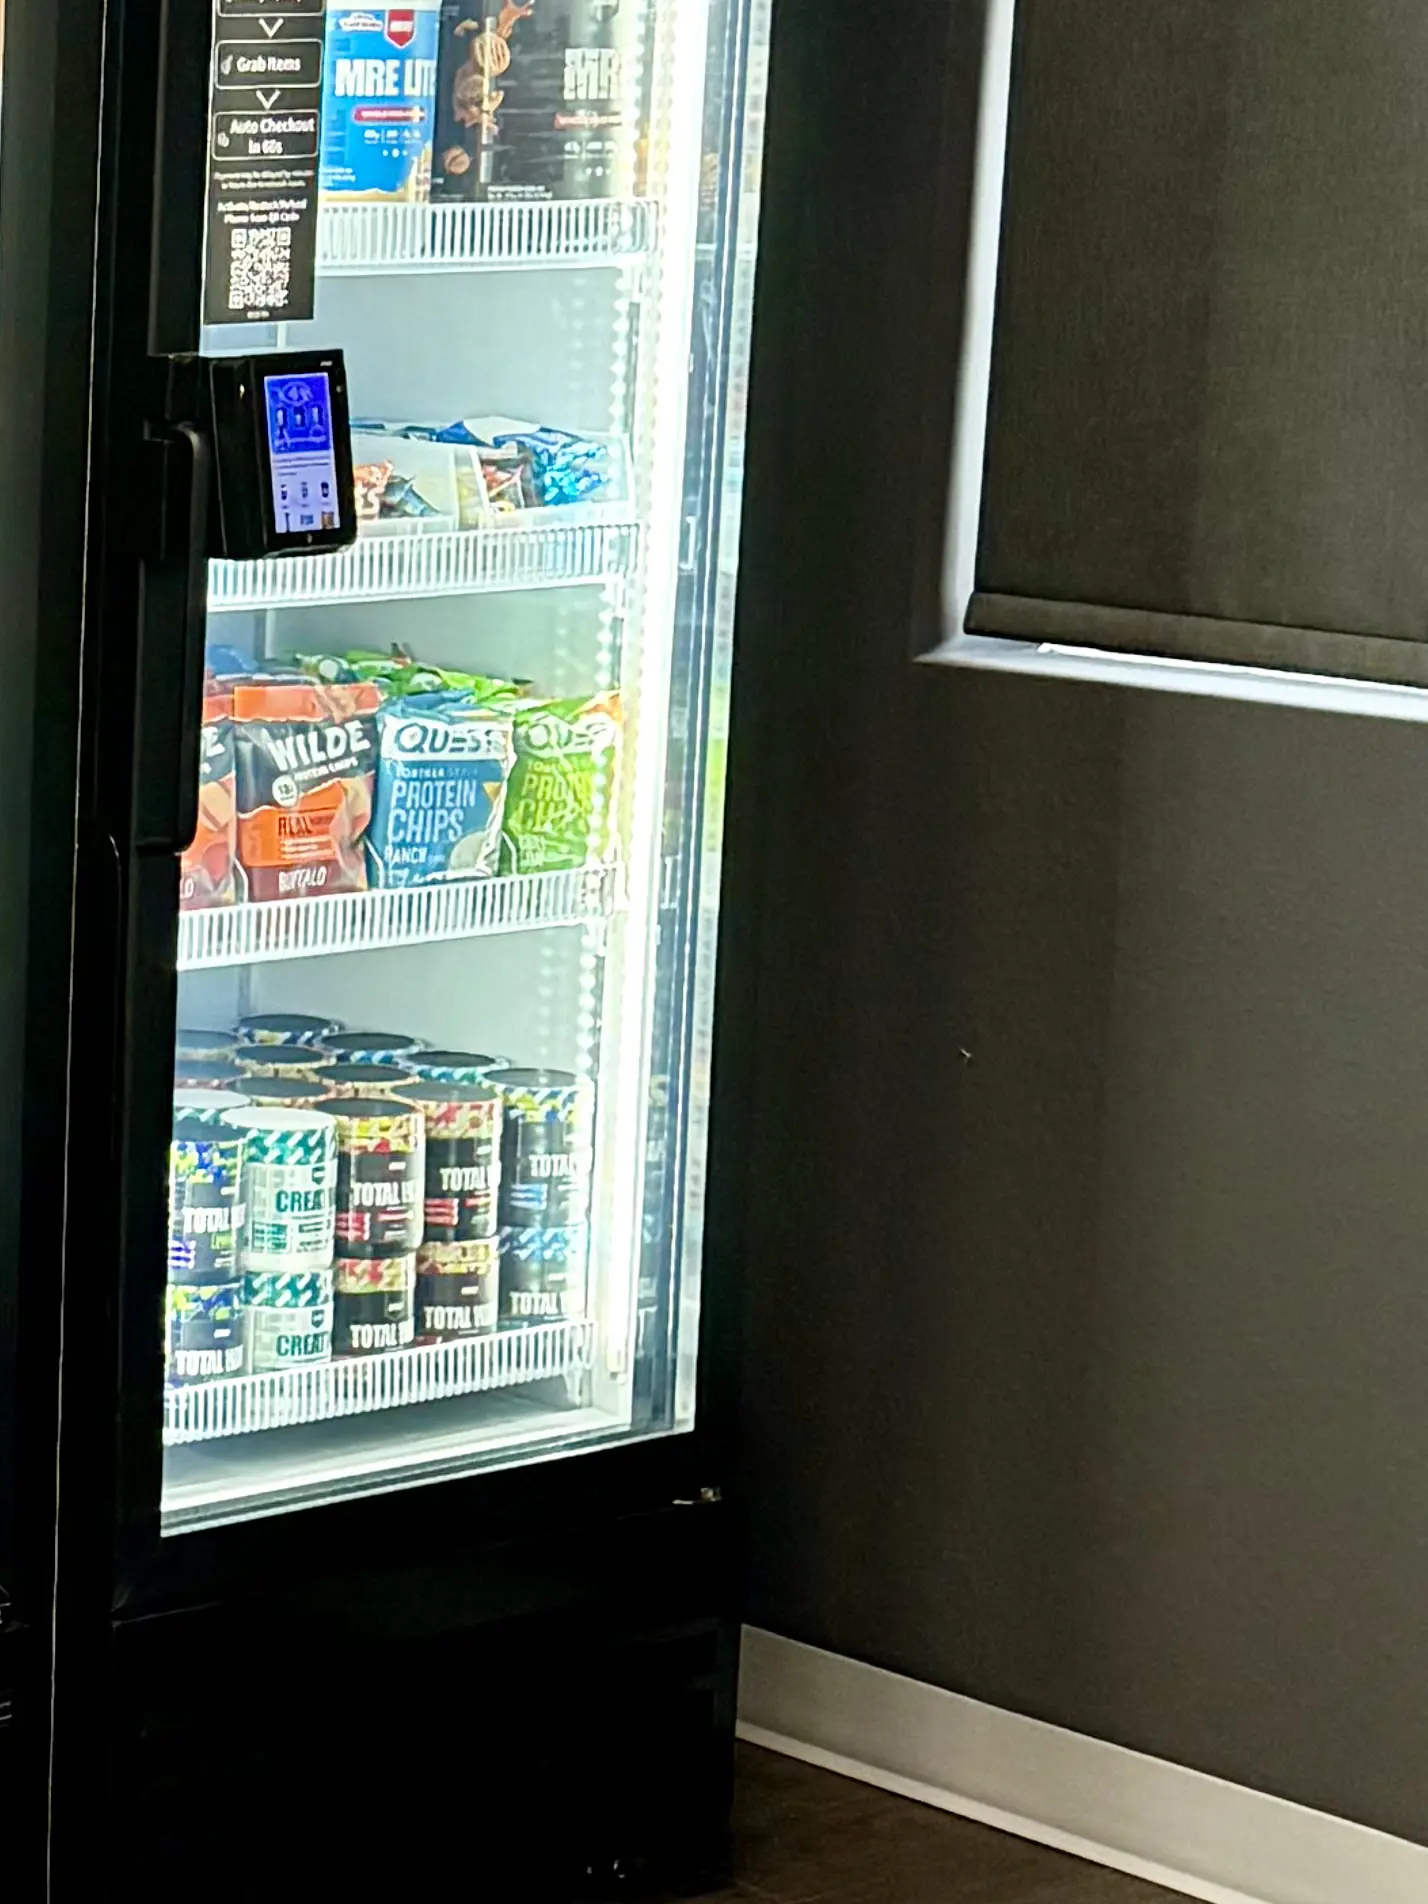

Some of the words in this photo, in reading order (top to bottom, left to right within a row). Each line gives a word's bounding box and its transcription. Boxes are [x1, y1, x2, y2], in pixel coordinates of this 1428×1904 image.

[335, 58, 400, 97] MRE
[263, 720, 371, 771] WILDE
[392, 779, 476, 810] PROTEIN
[388, 808, 464, 844] CHIPS
